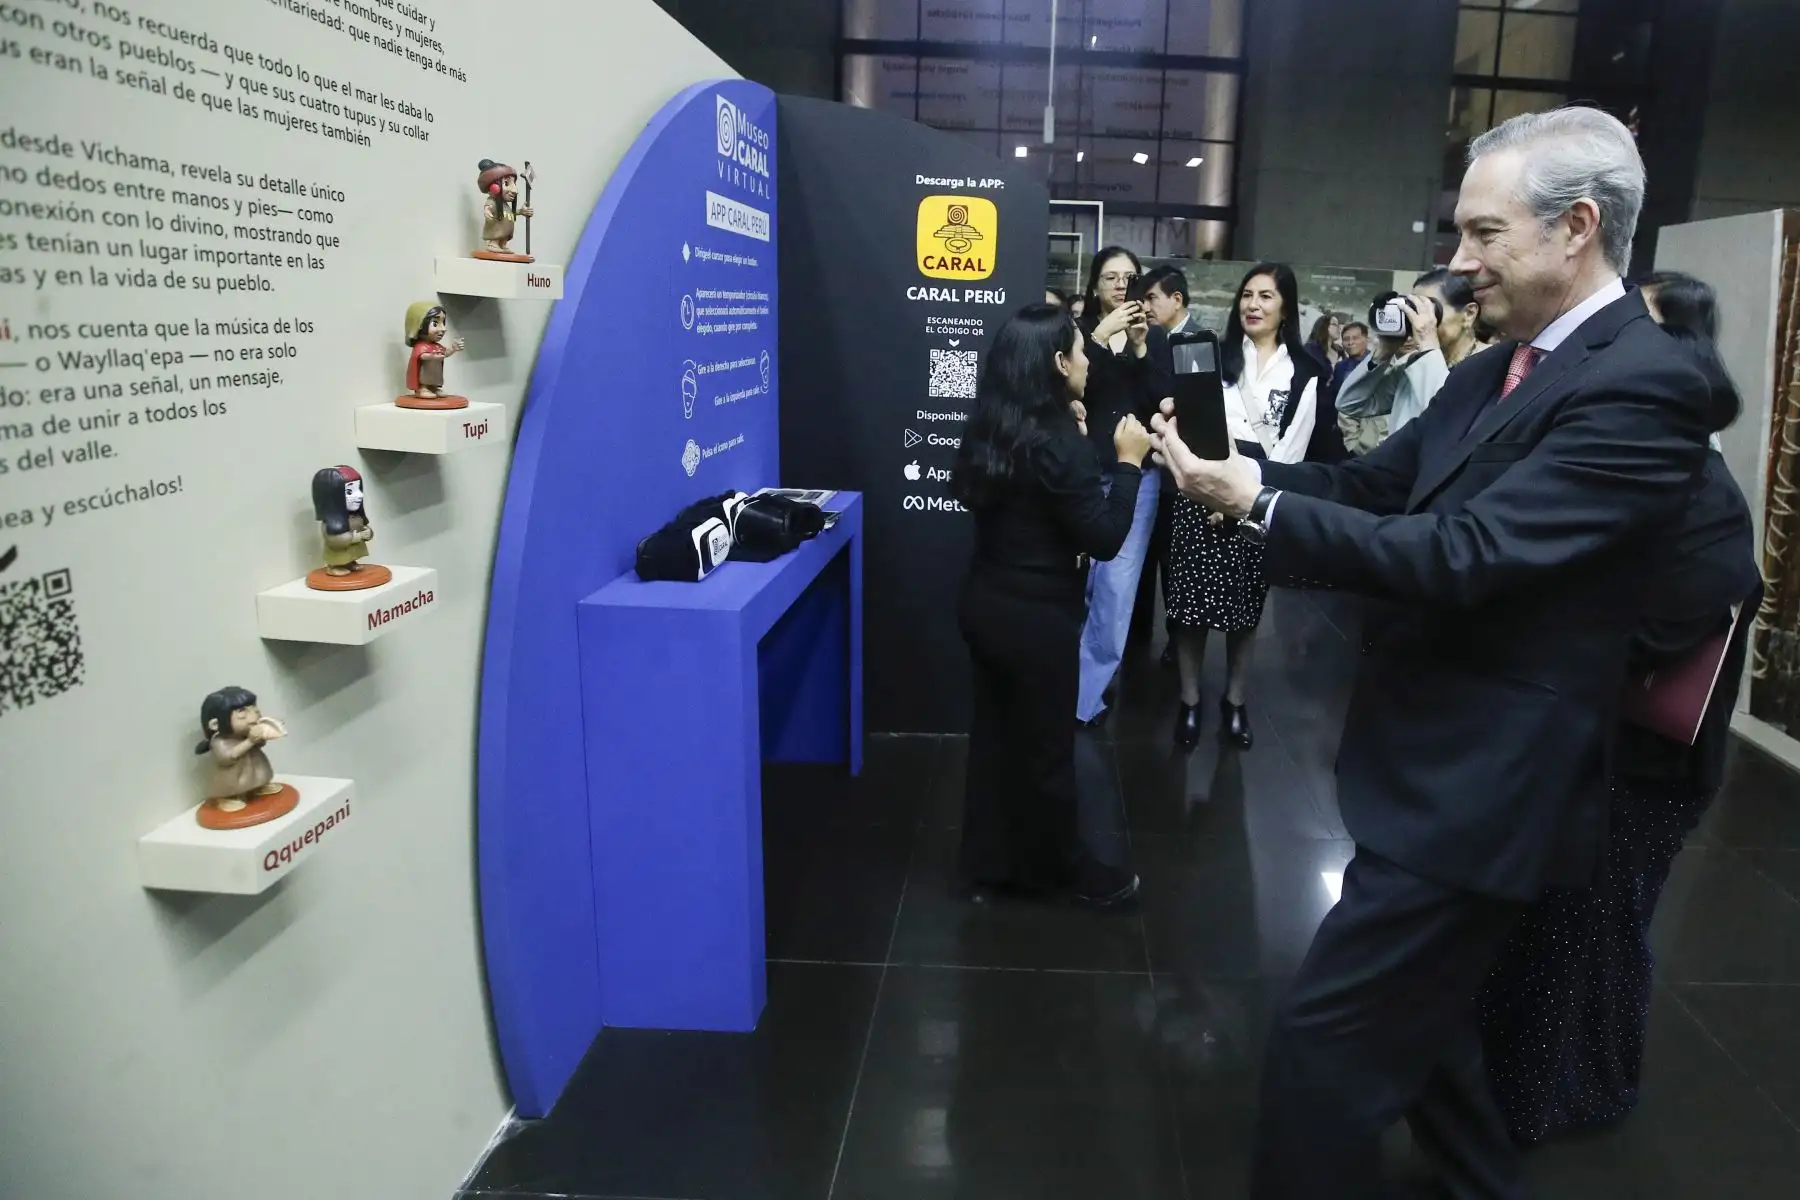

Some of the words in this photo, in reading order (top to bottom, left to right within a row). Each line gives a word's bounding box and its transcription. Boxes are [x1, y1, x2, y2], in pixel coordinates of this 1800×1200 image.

[397, 2, 427, 25] cuidar
[429, 18, 435, 31] y
[349, 24, 370, 42] que
[373, 34, 403, 56] nadie
[405, 48, 433, 70] tenga
[435, 60, 447, 74] de
[449, 66, 467, 83] más
[395, 23, 402, 37] y
[405, 27, 445, 55] mujeres,
[0, 4, 44, 31] con
[52, 20, 112, 51] otros
[119, 40, 196, 75] pueblos
[224, 71, 234, 90] y
[239, 77, 268, 95] que
[273, 86, 295, 103] sus
[299, 93, 340, 116] cuatro
[344, 105, 376, 127] tupus
[379, 116, 386, 133] y
[388, 121, 400, 133] su
[403, 124, 429, 142] collar
[94, 2, 131, 26] nos
[138, 14, 218, 53] recuerda
[224, 43, 253, 65] que
[258, 52, 293, 77] todo
[297, 64, 309, 83] lo
[314, 73, 338, 93] que
[342, 81, 352, 97] el
[356, 89, 377, 105] mar
[381, 92, 395, 111] les
[398, 101, 422, 119] daba
[425, 107, 434, 123] lo
[30, 47, 82, 73] eran
[90, 57, 108, 80] la
[116, 69, 167, 95] señal
[173, 82, 195, 103] de
[202, 92, 232, 111] que
[238, 97, 258, 119] las
[264, 108, 318, 134] mujeres
[322, 121, 371, 147] también
[737, 108, 769, 150] Museo
[0, 126, 74, 158] desde
[81, 140, 175, 177] Vichama,
[181, 163, 232, 184] revela
[237, 173, 254, 187] su
[259, 174, 307, 196] detalle
[311, 182, 345, 202] único
[737, 139, 769, 178] CARAL
[36, 165, 107, 194] dedos
[114, 181, 165, 202] entre
[172, 190, 229, 210] manos
[234, 200, 243, 216] y
[297, 208, 334, 224] como
[717, 159, 770, 200] VIRTUAL
[916, 174, 964, 189] Descarga
[966, 177, 976, 187] la
[979, 179, 1004, 189] APP:
[102, 210, 139, 228] con
[146, 211, 164, 231] lo
[170, 214, 228, 239] divino,
[234, 225, 312, 245] mostrando
[316, 234, 340, 250] que
[711, 201, 726, 223] APP
[728, 207, 750, 231] CARAL
[26, 232, 100, 255] tenían
[107, 241, 133, 257] un
[140, 239, 188, 265] lugar
[194, 244, 282, 267] importante
[287, 256, 303, 268] en
[307, 253, 325, 269] las
[923, 255, 986, 272] CARAL
[33, 268, 46, 290] y
[55, 269, 83, 285] en
[91, 265, 108, 286] la
[115, 268, 157, 288] vida
[164, 269, 186, 288] de
[192, 276, 211, 289] su
[217, 274, 275, 294] pueblo.
[527, 272, 551, 289] Huno
[906, 286, 960, 302] CARAL
[964, 287, 1006, 304] PERÚ
[28, 323, 71, 340] nos
[78, 320, 148, 339] cuenta
[155, 322, 190, 341] que
[195, 318, 210, 336] la
[215, 318, 269, 335] música
[274, 317, 291, 334] de
[295, 317, 314, 333] los
[925, 326, 934, 334] EL
[937, 324, 970, 335] CÓDIGO
[972, 328, 984, 336] QR
[927, 316, 983, 326] ESCANEANDO
[35, 356, 51, 371] o
[58, 348, 184, 374] Wayllaq'epa
[214, 348, 235, 362] no
[240, 346, 263, 361] era
[268, 342, 297, 358] solo
[40, 388, 76, 403] era
[84, 383, 123, 400] una
[130, 375, 184, 396] señal,
[190, 376, 211, 391] un
[217, 368, 283, 389] mensaje,
[42, 413, 71, 436] de
[78, 409, 121, 431] unir
[128, 412, 139, 425] a
[145, 402, 198, 423] todos
[203, 399, 227, 416] los
[463, 419, 488, 439] Tupi
[17, 446, 54, 472] del
[62, 440, 118, 465] valle.
[42, 505, 55, 527] y
[63, 475, 183, 516] escúchalos!
[367, 590, 434, 631] Mamacha
[263, 799, 351, 872] Qquepani
